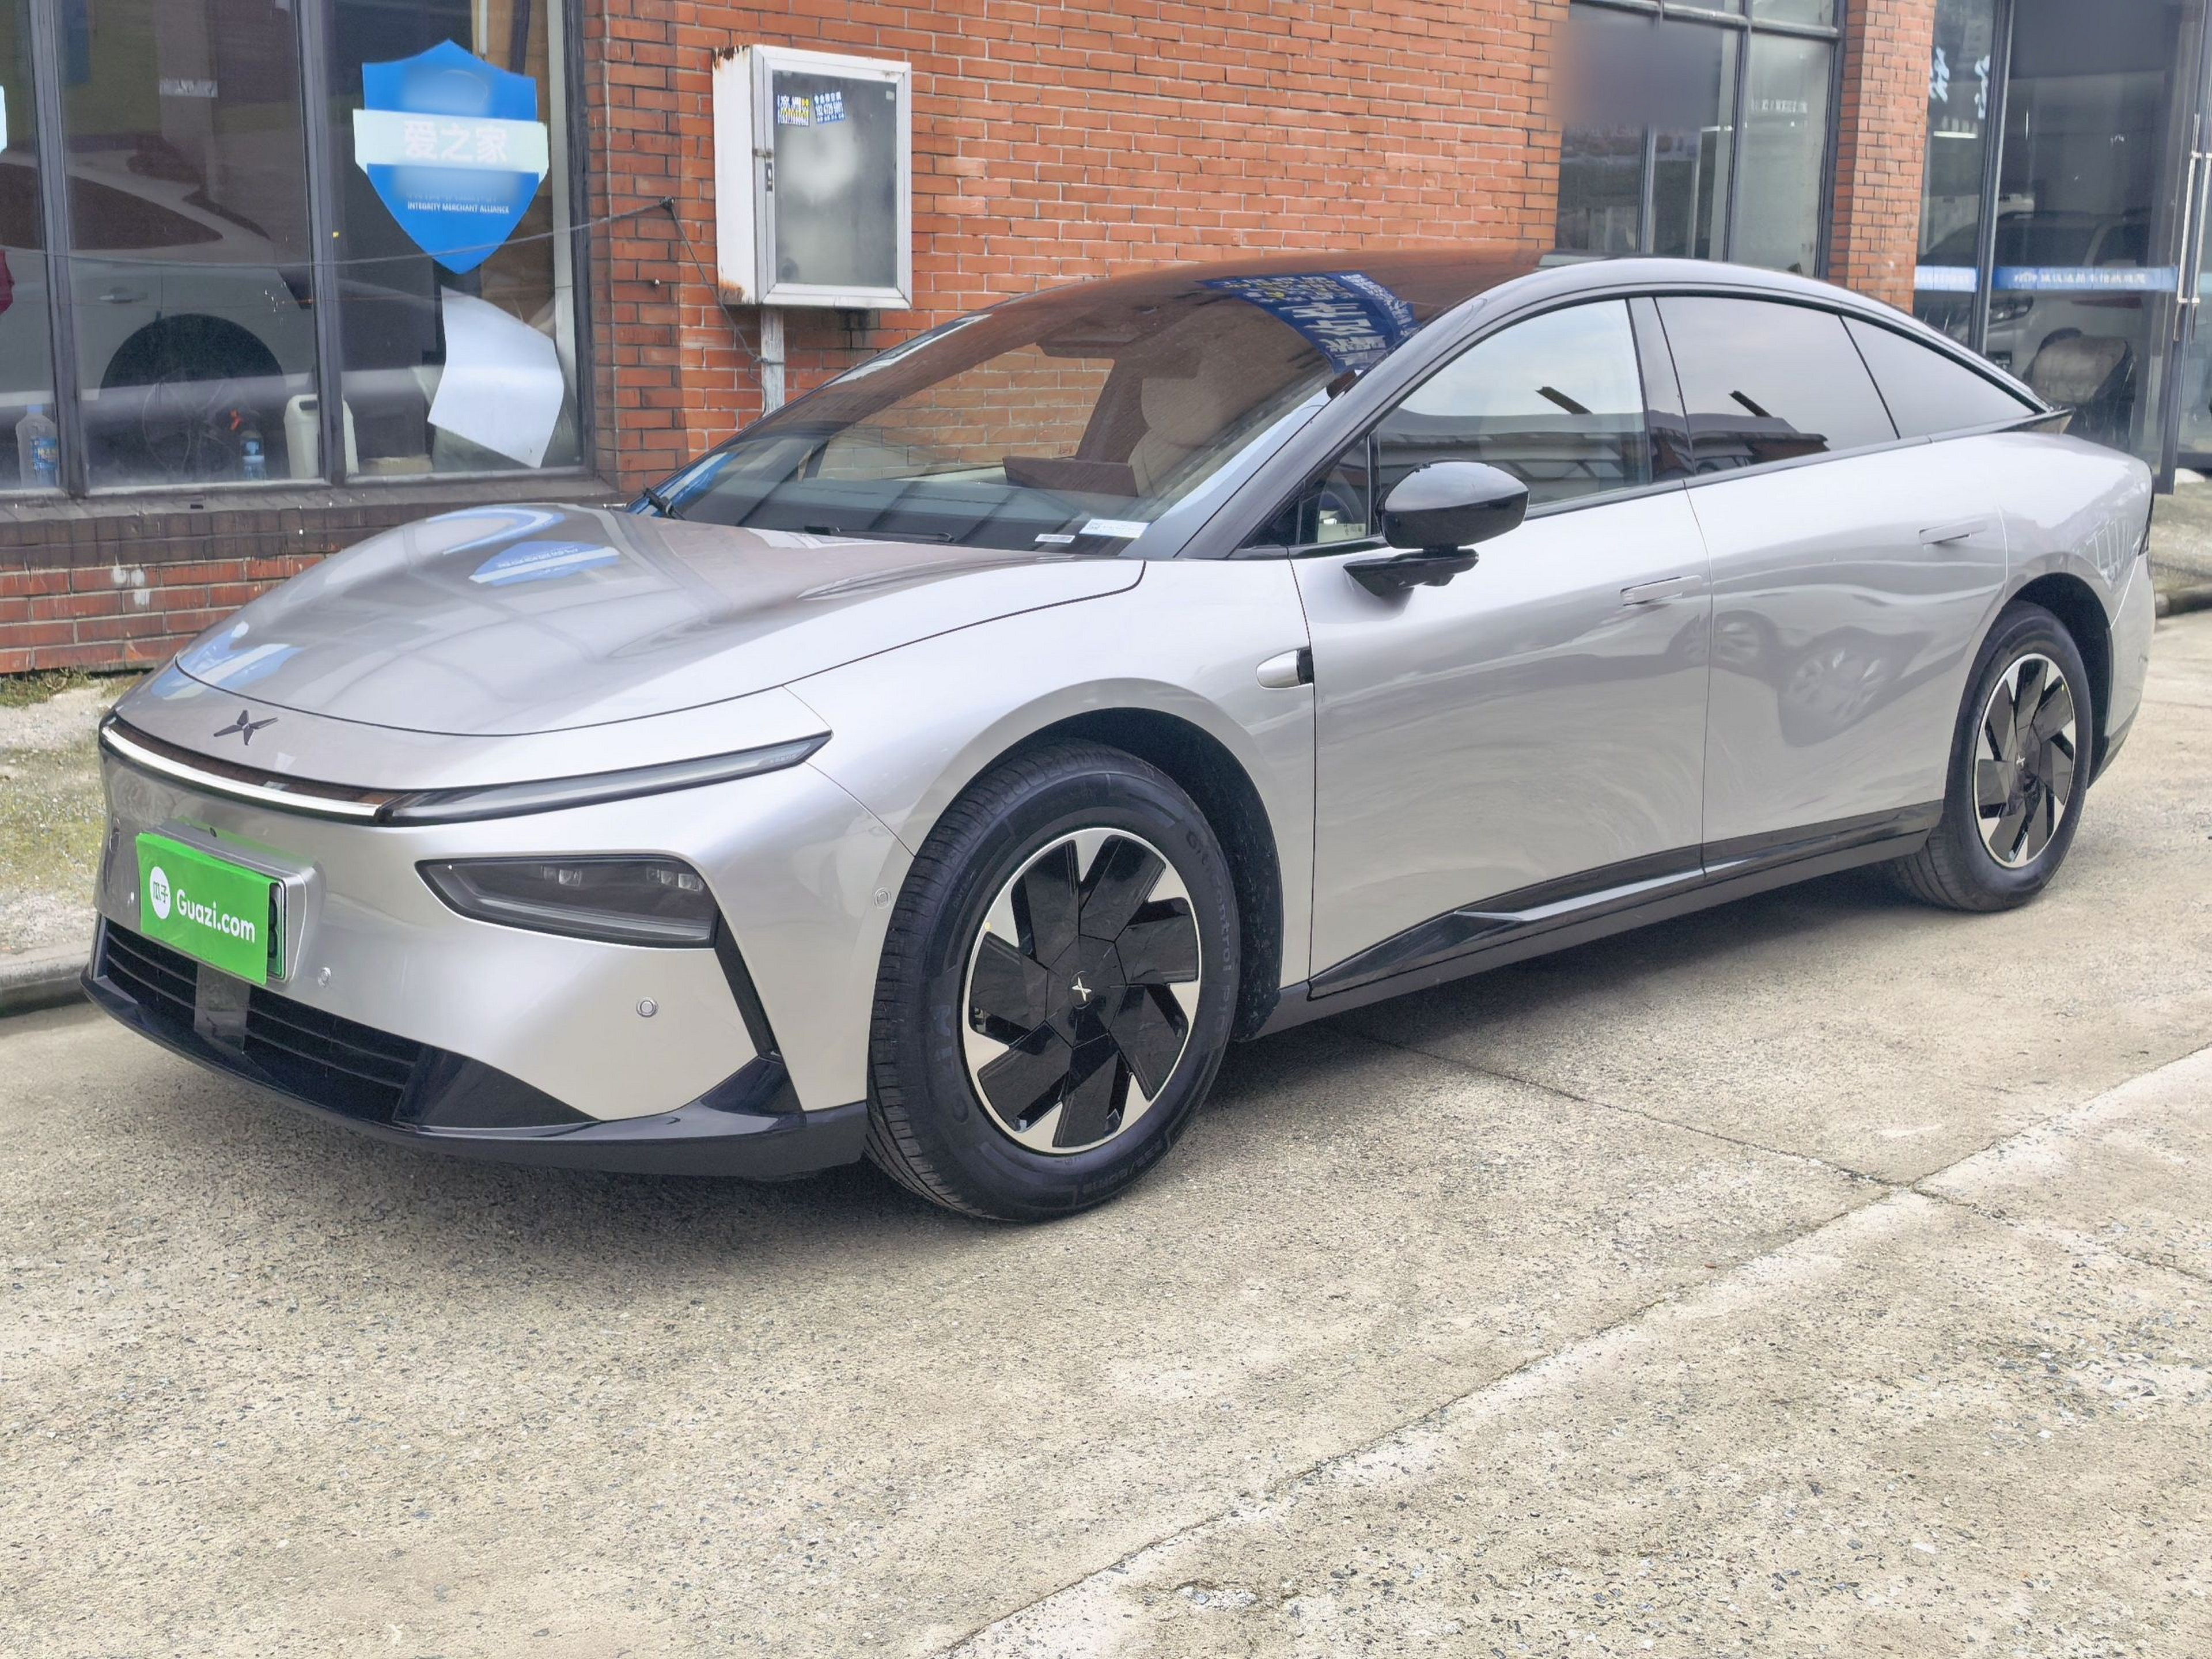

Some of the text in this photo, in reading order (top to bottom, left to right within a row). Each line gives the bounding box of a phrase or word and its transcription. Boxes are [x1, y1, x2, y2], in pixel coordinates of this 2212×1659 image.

[404, 120, 507, 163] 爱之家
[407, 201, 441, 211] INTEGRITY
[442, 203, 478, 213] MERCHANT
[153, 881, 168, 904] 瓜子
[176, 888, 256, 943] Guazi.com
